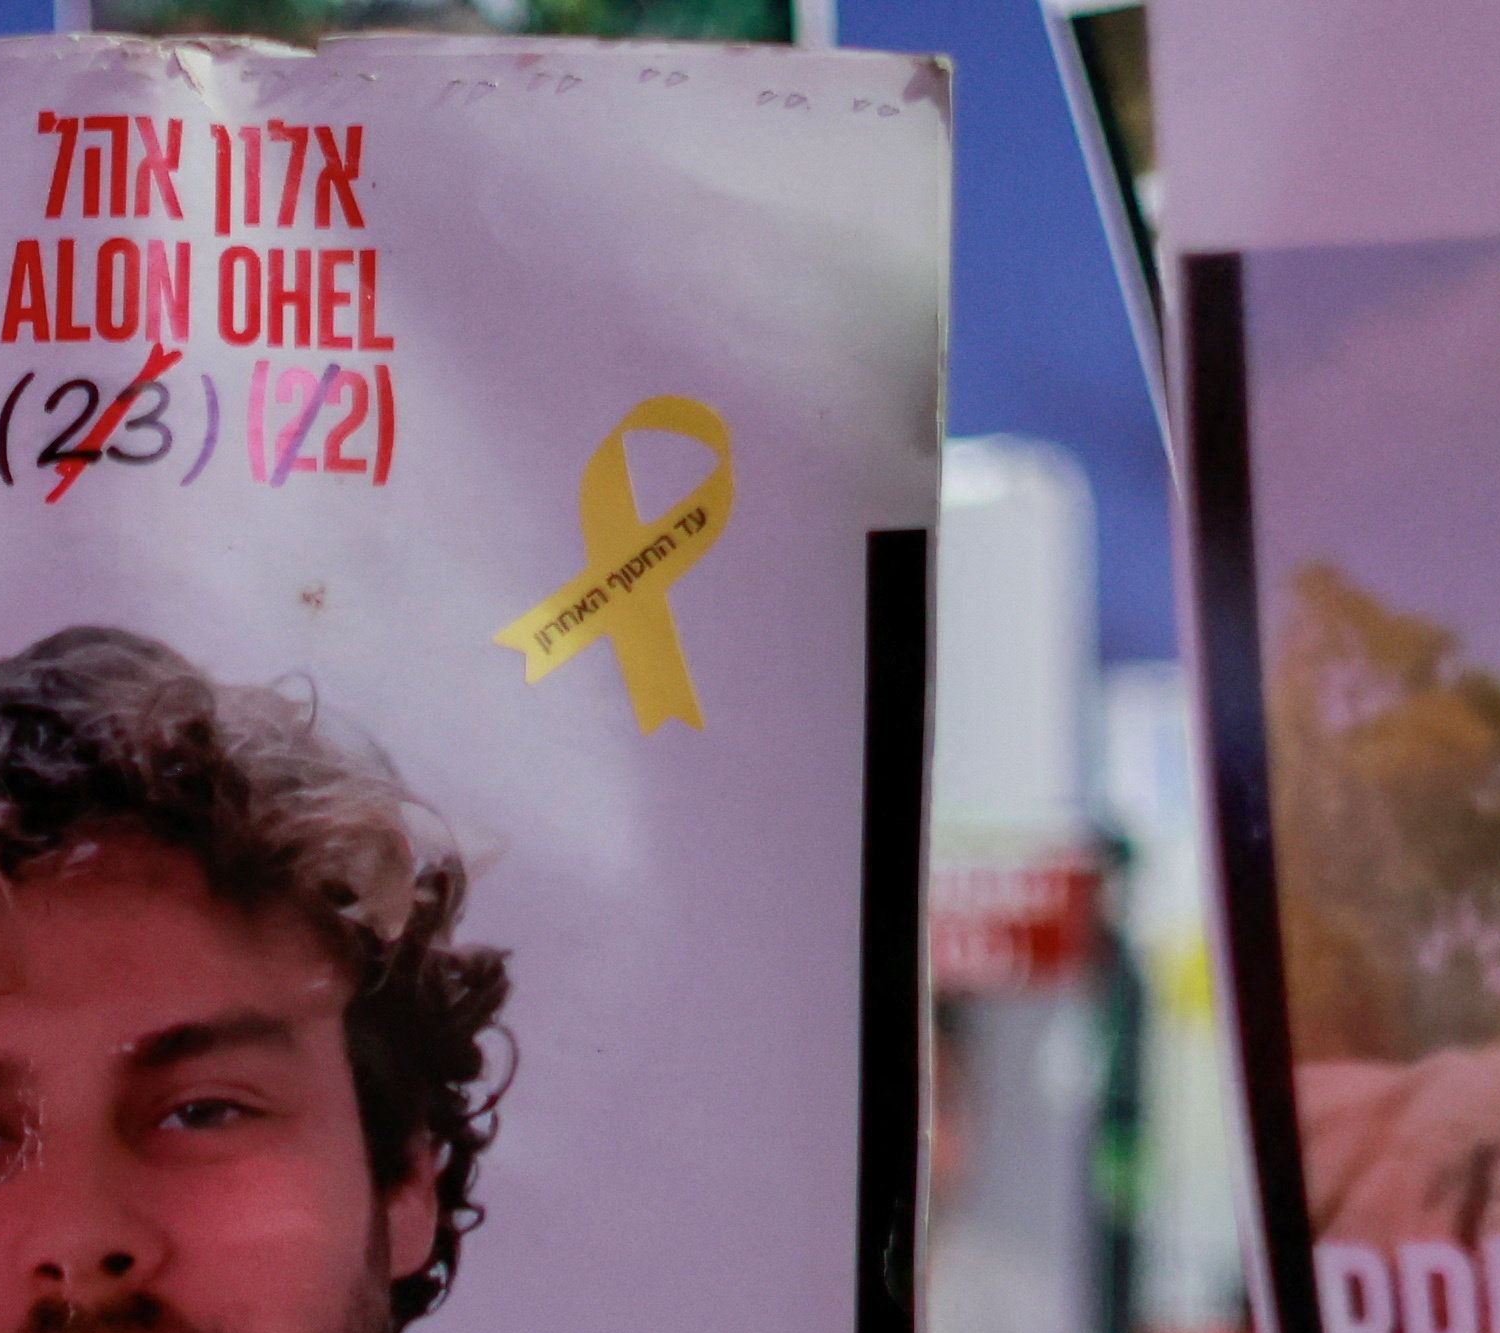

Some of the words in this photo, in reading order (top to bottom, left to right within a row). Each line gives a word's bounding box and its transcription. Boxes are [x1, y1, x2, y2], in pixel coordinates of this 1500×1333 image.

[37, 110, 185, 221] אהל
[210, 119, 366, 238] אלון
[1, 237, 191, 344] ALON
[218, 246, 395, 351] OHEL
[673, 507, 708, 537] עד
